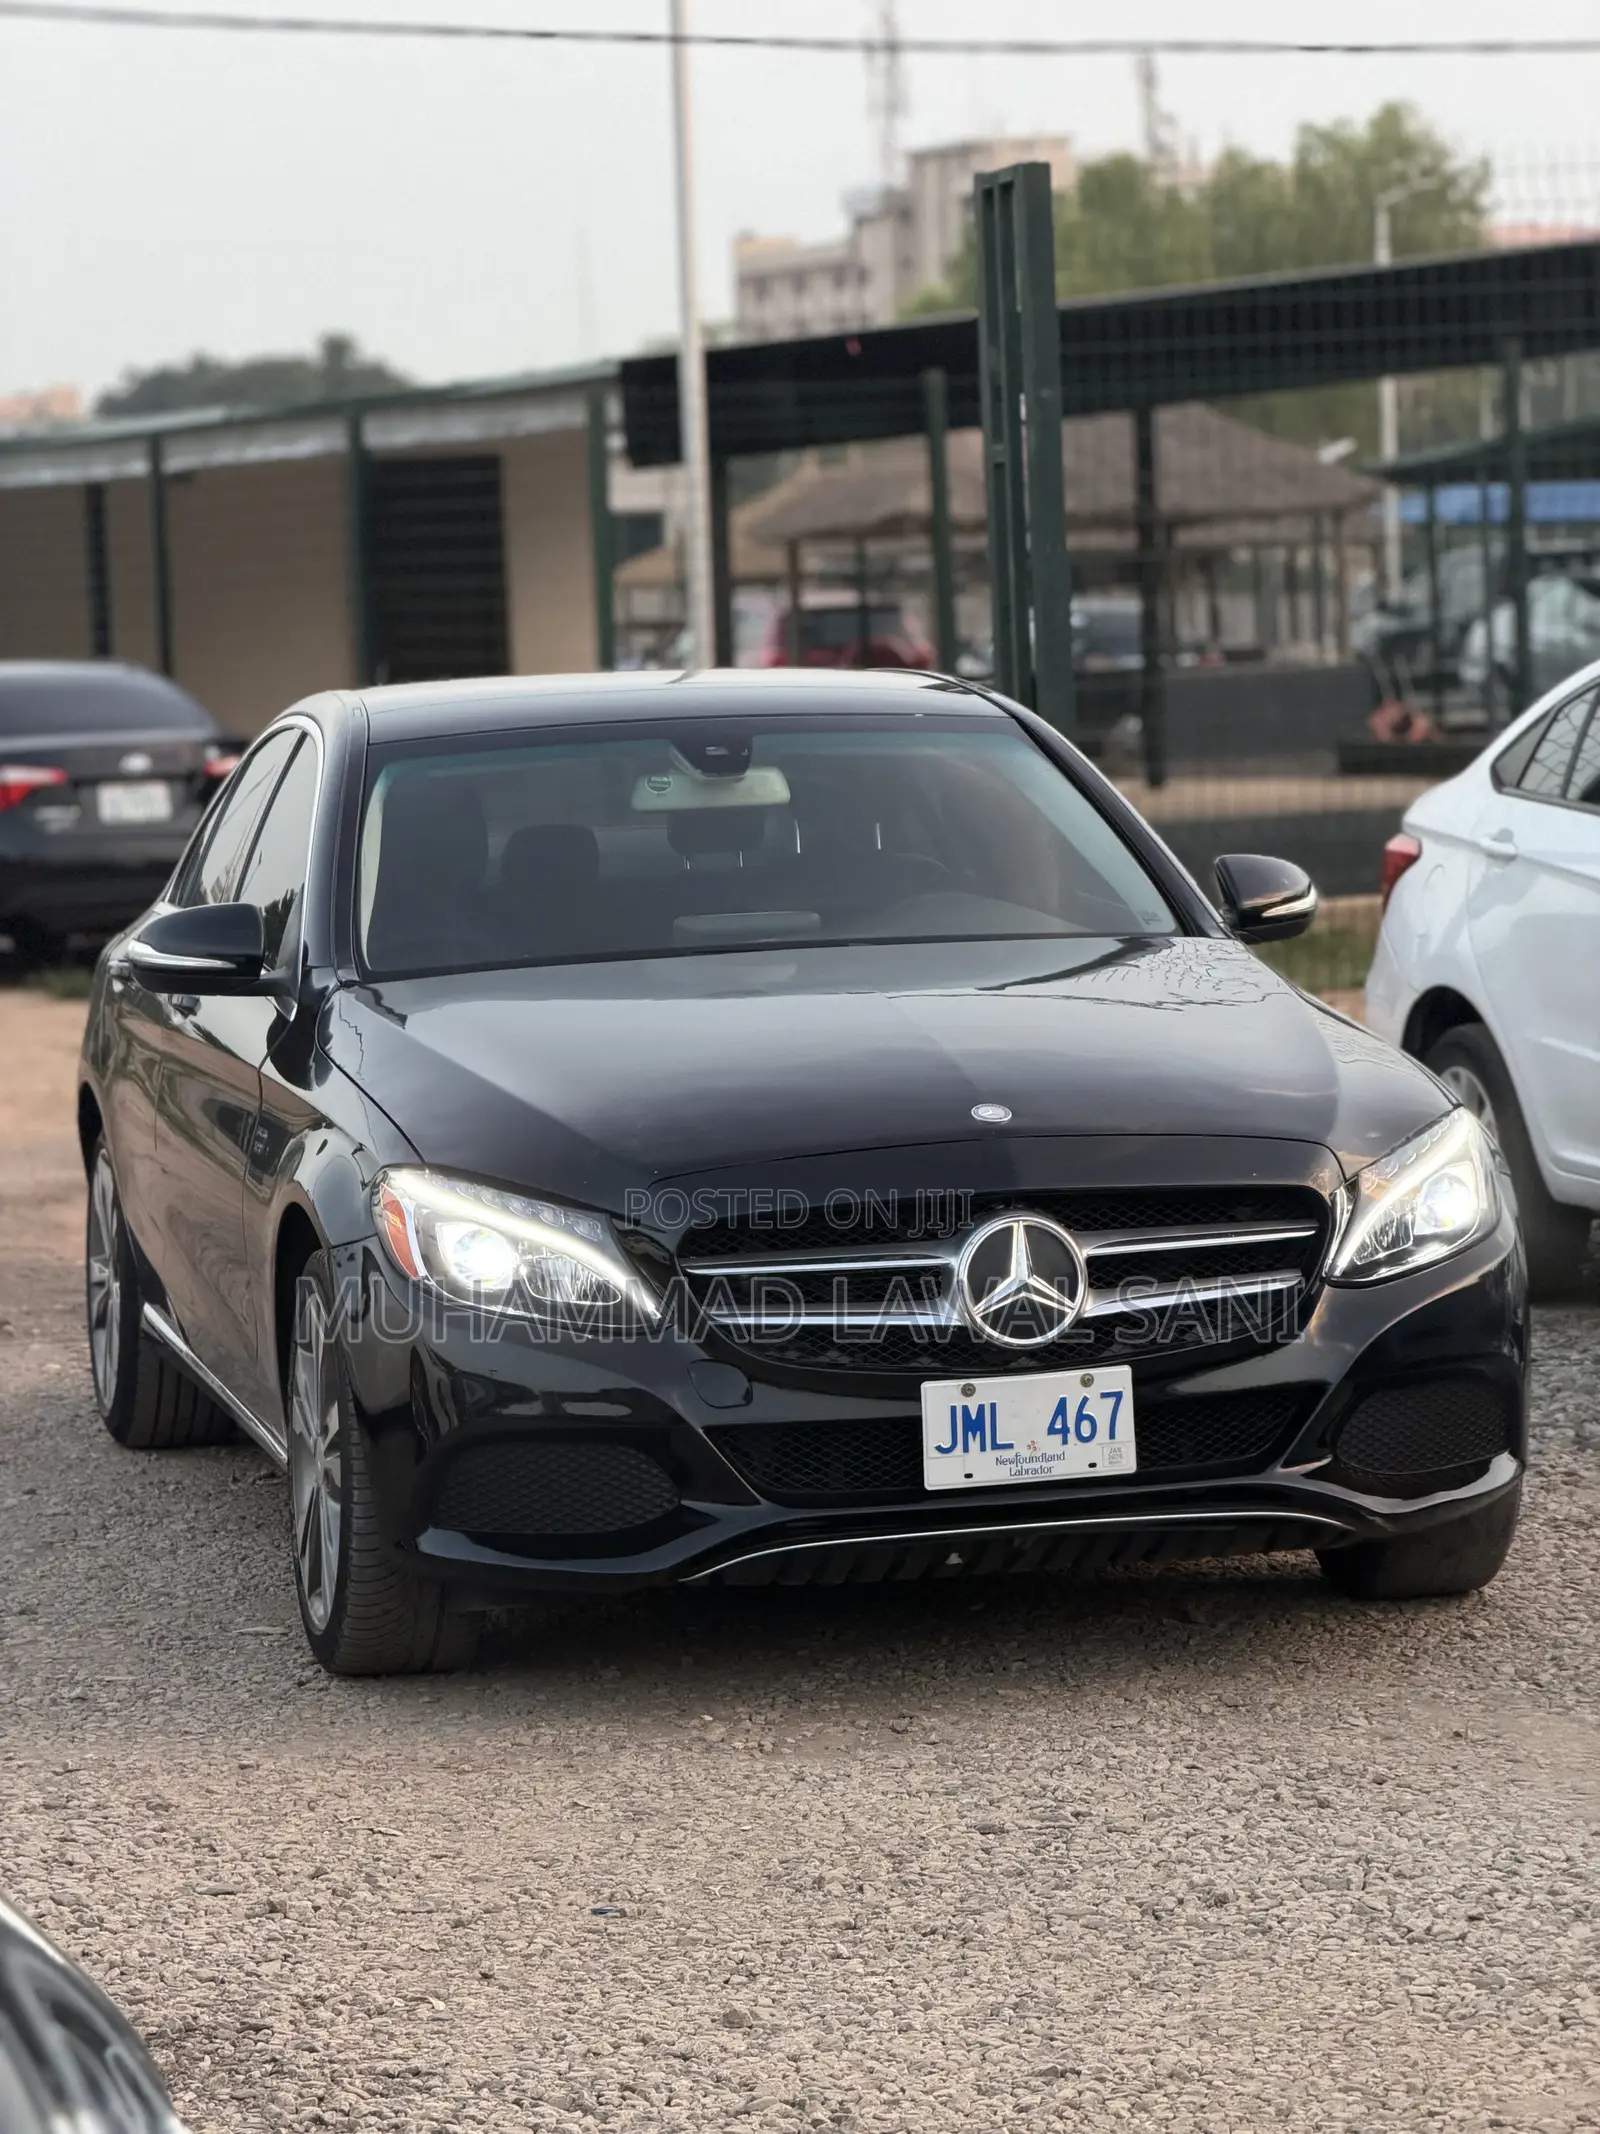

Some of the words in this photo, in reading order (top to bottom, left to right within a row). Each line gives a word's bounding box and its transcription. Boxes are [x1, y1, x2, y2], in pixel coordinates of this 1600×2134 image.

[934, 1402, 1015, 1455] JML
[1047, 1390, 1124, 1446] 467
[995, 1450, 1066, 1468] Newfoundland
[1009, 1464, 1055, 1477] Labrador
